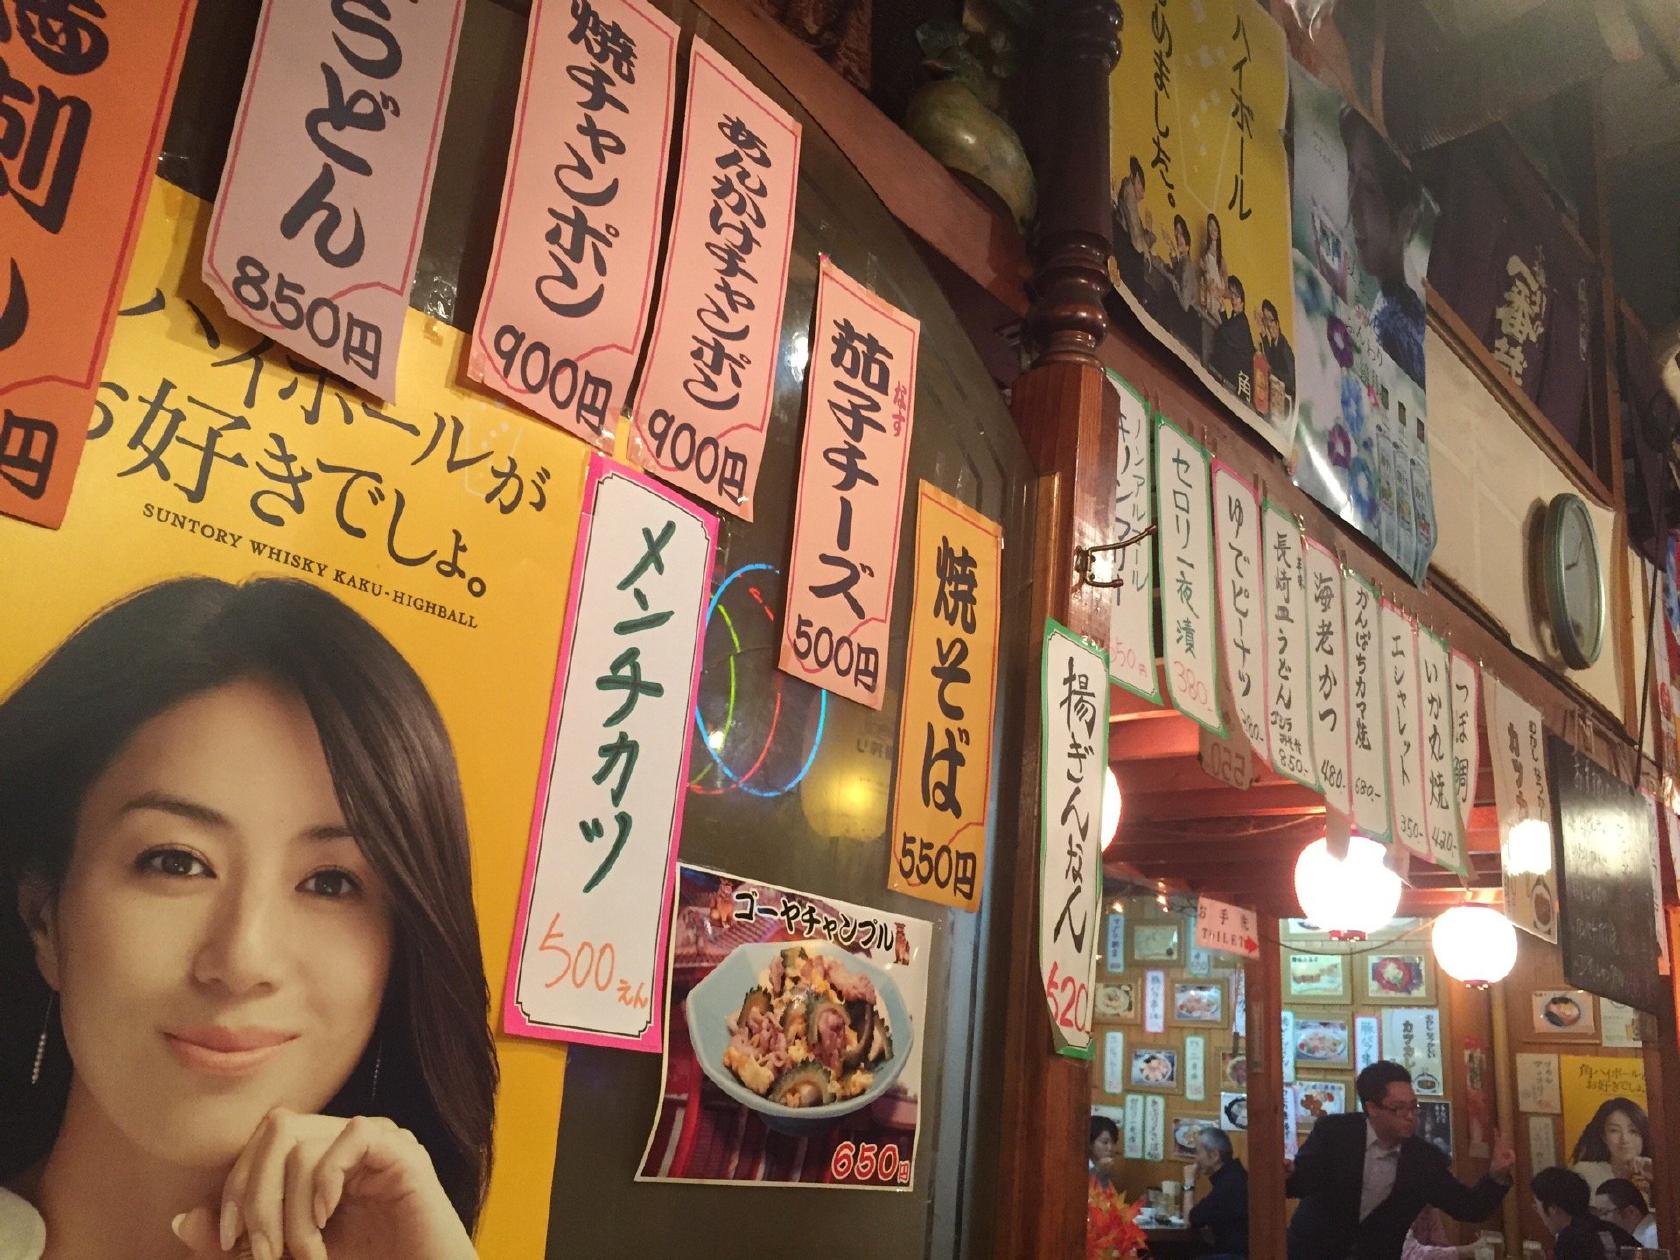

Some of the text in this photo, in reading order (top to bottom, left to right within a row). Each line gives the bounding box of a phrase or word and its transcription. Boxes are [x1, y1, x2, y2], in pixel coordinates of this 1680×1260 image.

[233, 256, 381, 380] 850円
[493, 324, 614, 435] 900円
[648, 408, 748, 506] 900円
[809, 318, 895, 621] 茄子チーズ
[143, 502, 478, 630] SUNTORY WHISKY KAKU-HIGHBALL
[579, 520, 677, 894] メンチカツ
[793, 615, 880, 695] 500円
[922, 536, 978, 819] 焼そば
[733, 890, 896, 953] ゴーヤチャンプル
[901, 834, 978, 902] 550円
[830, 1142, 913, 1185] 650円
